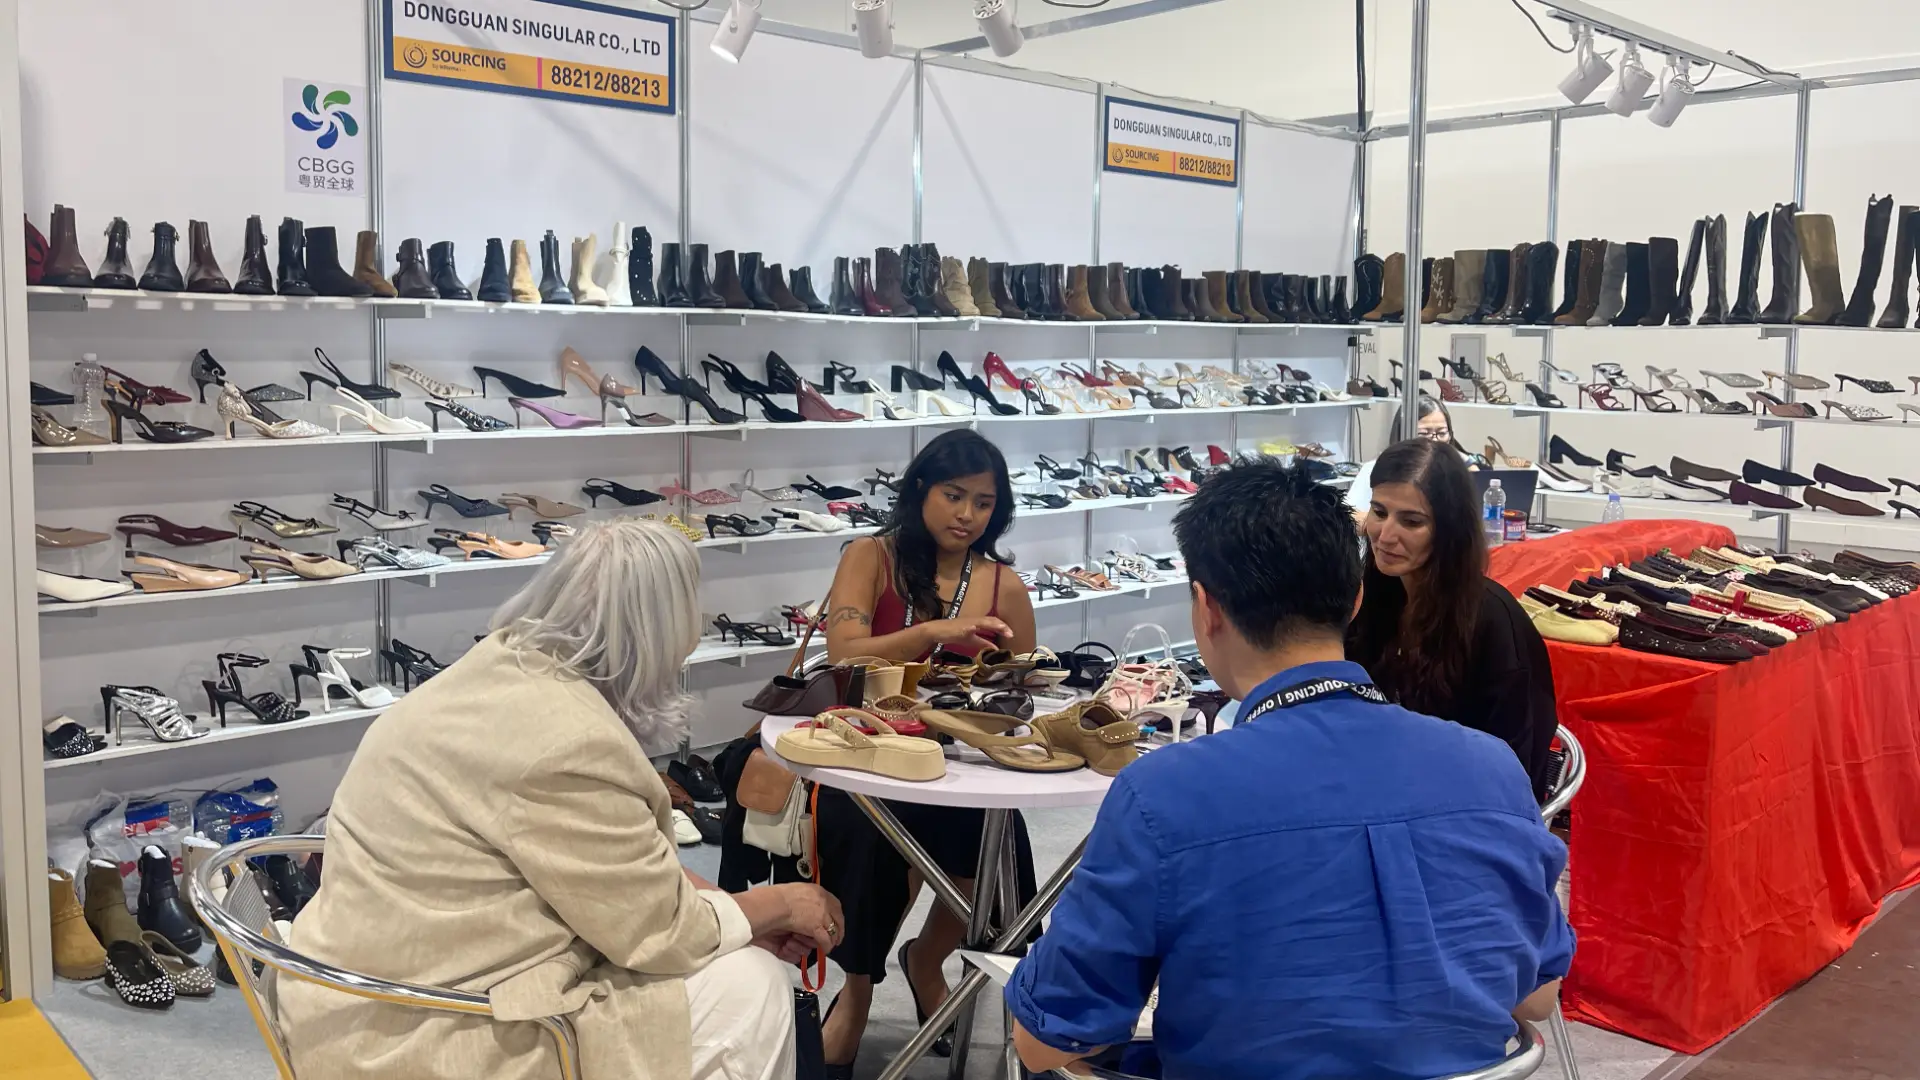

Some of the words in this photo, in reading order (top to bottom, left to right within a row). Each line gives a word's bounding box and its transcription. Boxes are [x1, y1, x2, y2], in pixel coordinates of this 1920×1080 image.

[404, 1, 508, 33] DONGGUAN
[512, 18, 595, 47] SINGULAR
[599, 32, 629, 54] CO.,
[633, 38, 661, 56] LTD
[431, 48, 507, 72] SOURCING
[551, 65, 661, 98] 88212/88213
[1113, 117, 1161, 136] DONGGUAN
[1162, 125, 1201, 142] SINGULAR
[1218, 135, 1232, 148] LTD
[298, 156, 355, 175] CBGG
[1125, 148, 1160, 162] SOURCING
[1179, 156, 1231, 176] 88212/88213
[298, 174, 355, 191] 粤贸全球
[957, 580, 968, 602] MAGIC
